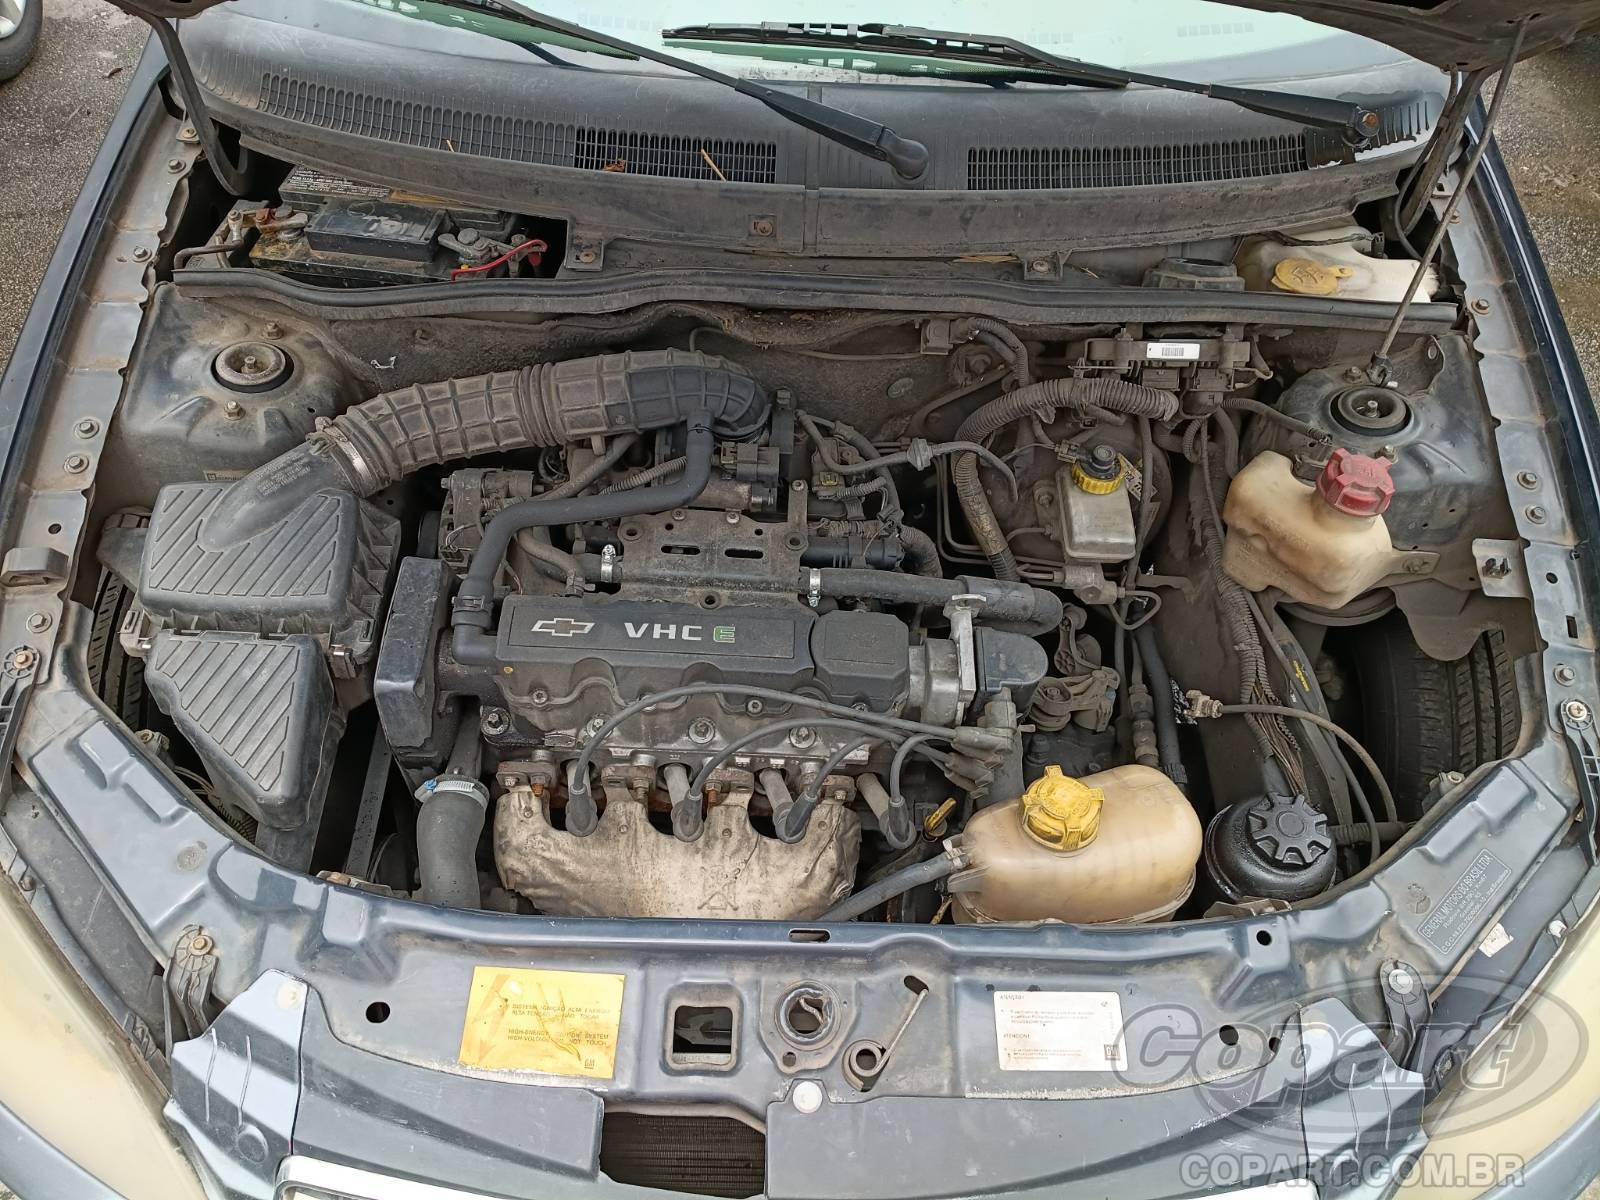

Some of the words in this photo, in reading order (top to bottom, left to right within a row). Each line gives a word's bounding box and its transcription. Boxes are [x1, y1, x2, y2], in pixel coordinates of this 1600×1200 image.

[624, 622, 703, 641] VHC
[713, 625, 736, 644] E
[1422, 912, 1444, 938] GENERAL
[1440, 892, 1462, 915] MOTORS
[1456, 883, 1469, 896] DO
[1463, 865, 1483, 889] BRASIL
